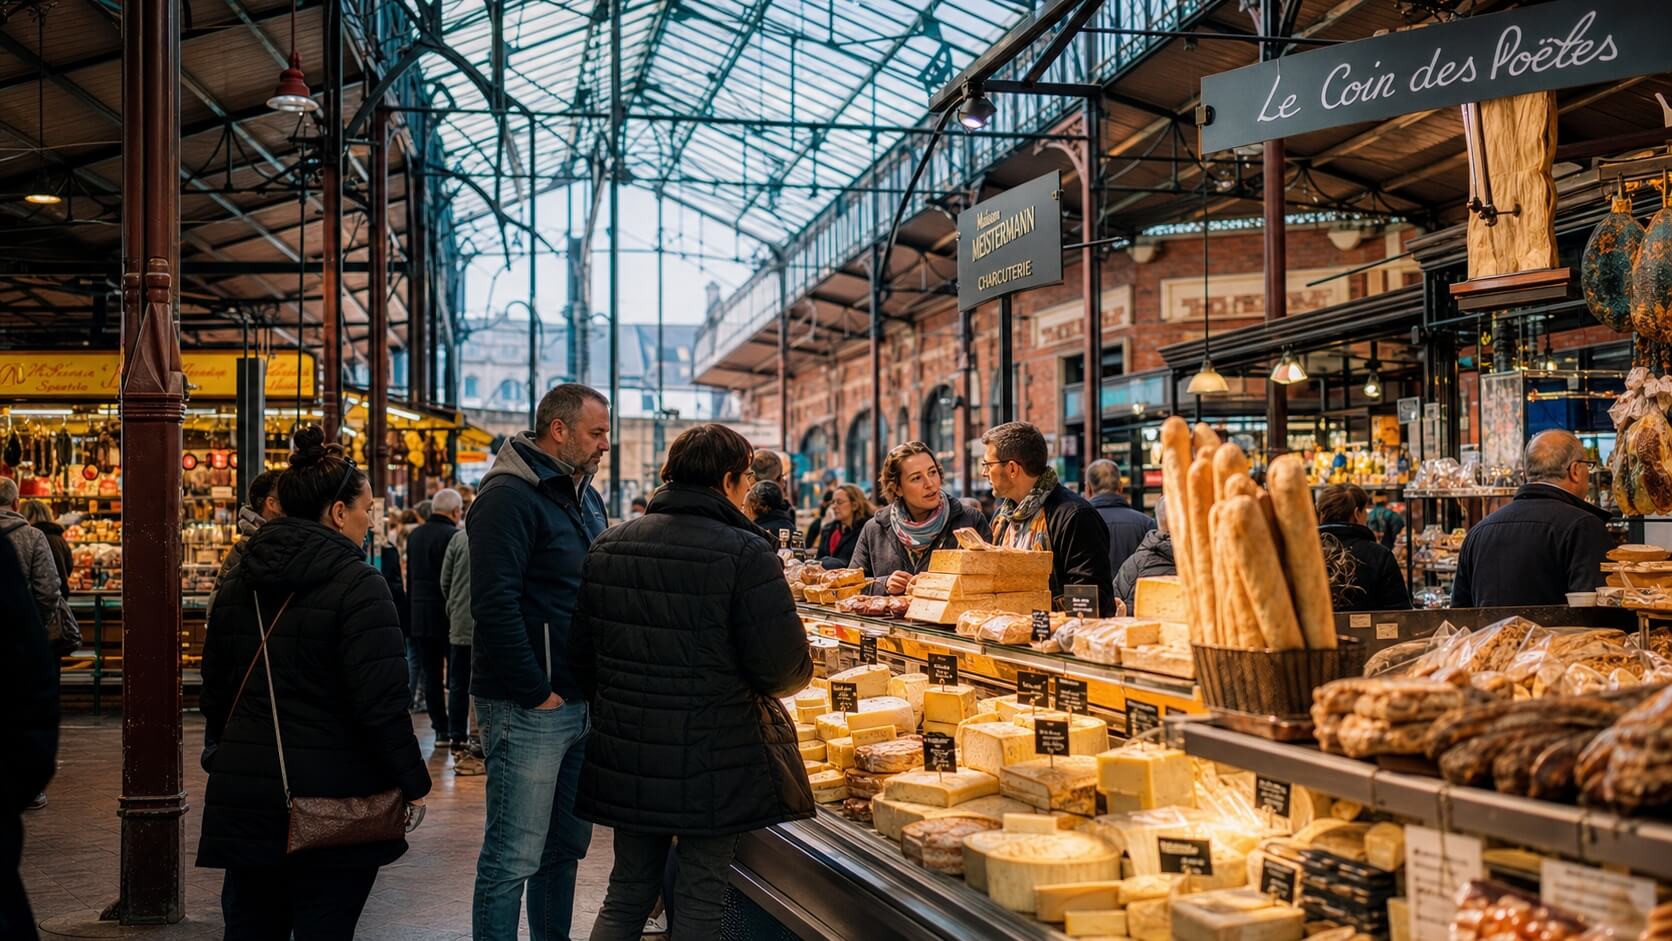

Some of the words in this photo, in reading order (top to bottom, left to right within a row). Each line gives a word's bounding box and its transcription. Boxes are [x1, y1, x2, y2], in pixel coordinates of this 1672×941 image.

[1257, 74, 1301, 123] Le
[1321, 60, 1396, 112] Coin
[1409, 47, 1477, 92] des
[972, 205, 1035, 262] MEISTERMANN
[978, 260, 1032, 290] CHARCUTERIE
